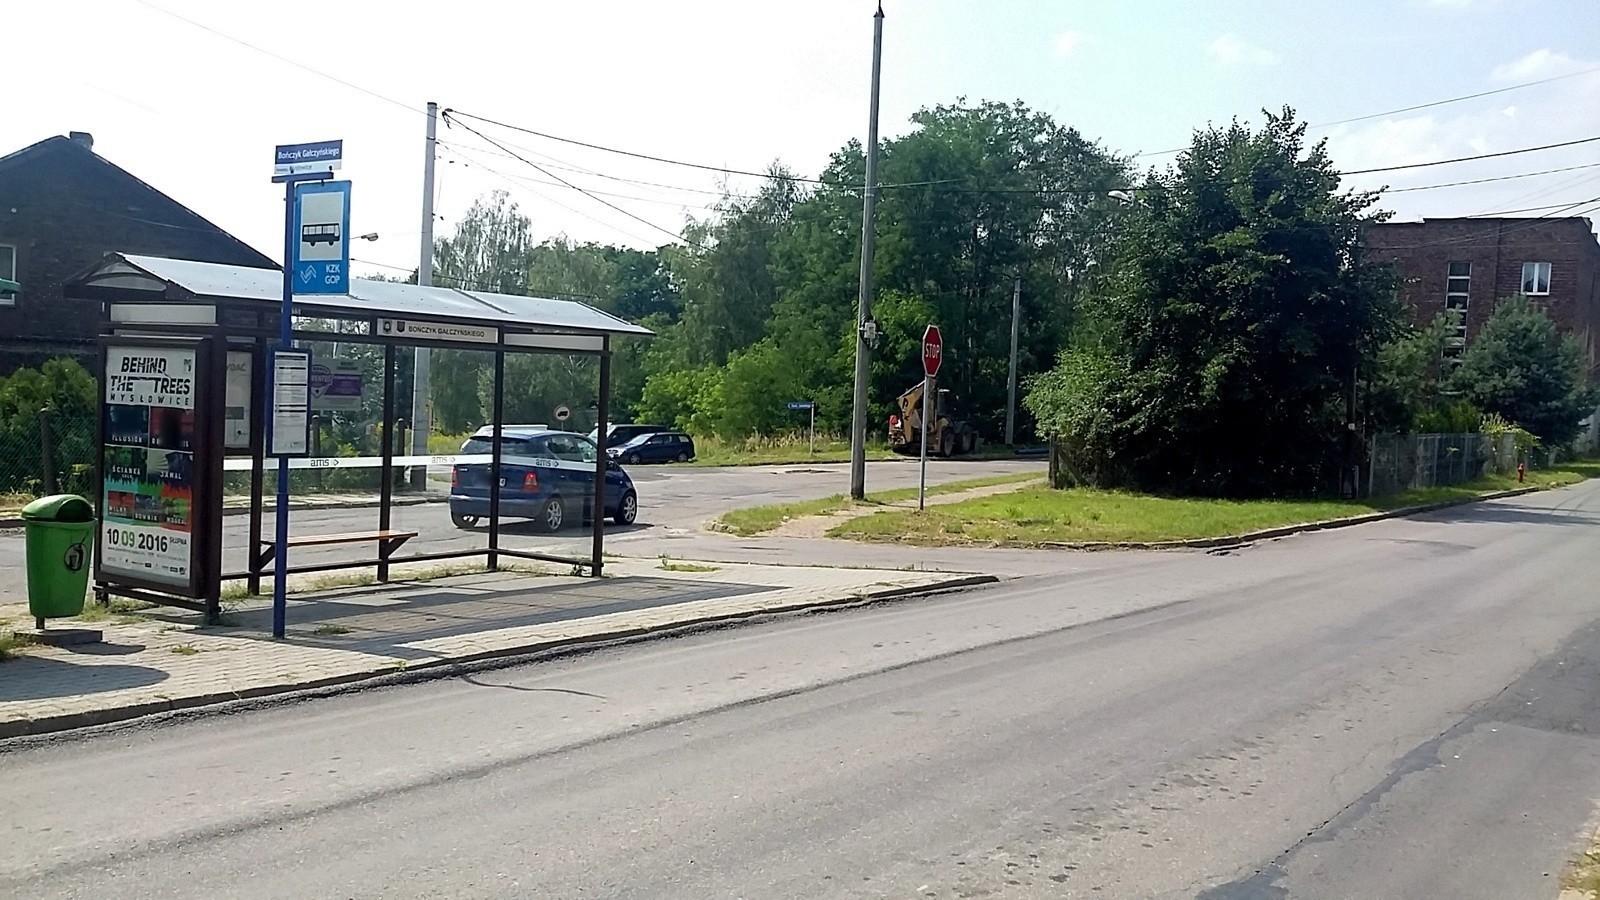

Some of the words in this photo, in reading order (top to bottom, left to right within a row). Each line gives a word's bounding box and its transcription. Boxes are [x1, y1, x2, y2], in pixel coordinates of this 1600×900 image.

[278, 150, 302, 159] Bończyk
[325, 264, 341, 273] KZK
[324, 275, 340, 284] GOP
[925, 343, 940, 359] STOP
[121, 357, 167, 374] BEHIND
[111, 376, 135, 391] THE
[153, 377, 190, 395] TREES
[310, 459, 330, 467] ams
[431, 456, 448, 464] ams
[107, 528, 119, 545] 10
[121, 530, 135, 548] 09
[138, 533, 168, 552] 2016
